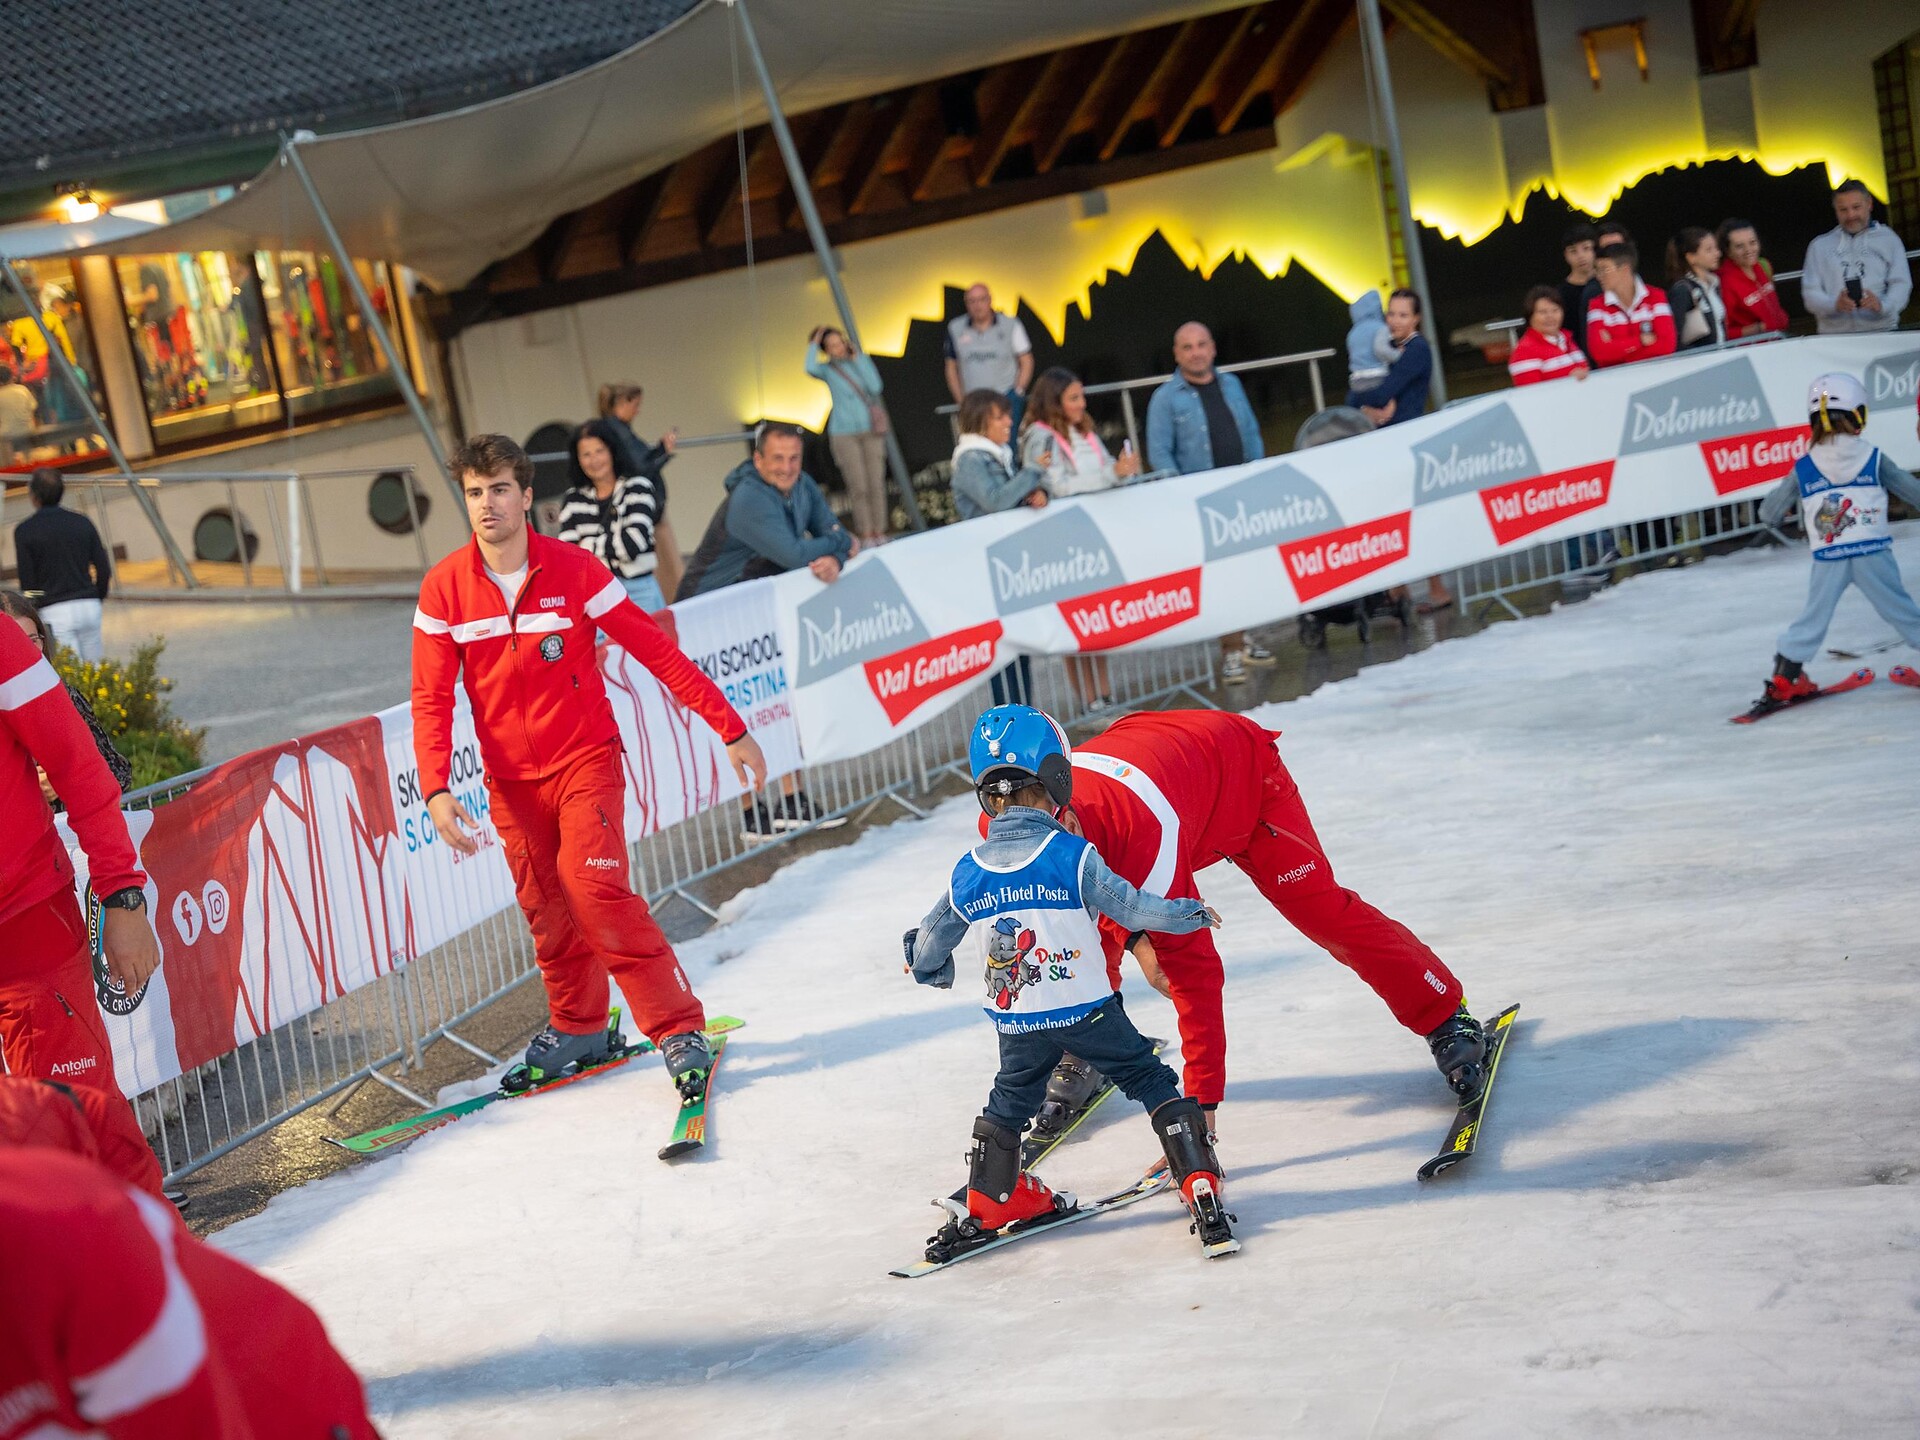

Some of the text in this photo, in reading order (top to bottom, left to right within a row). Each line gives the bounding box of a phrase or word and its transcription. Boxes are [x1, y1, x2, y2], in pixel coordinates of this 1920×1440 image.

[1632, 394, 1760, 443] Dolomites
[1419, 441, 1528, 492] Dolomites
[1712, 442, 1750, 474] Val
[1202, 494, 1329, 547] Dolomites
[1490, 477, 1603, 523] Val Gardena
[991, 546, 1110, 602] Dolomites
[1290, 529, 1404, 579] Val Gardena
[540, 595, 566, 609] COLMAR
[1071, 586, 1193, 638] Val Gardena
[719, 631, 782, 677] SCHOOL
[801, 601, 914, 667] Dolomites
[722, 666, 788, 709] RISTINA
[876, 640, 992, 699] Val Gardena
[585, 856, 620, 868] Antolini
[1277, 860, 1317, 886] Antolini
[1000, 884, 1034, 904] Hotel
[1036, 884, 1069, 902] Posta
[90, 907, 99, 956] SCUOLA
[1034, 947, 1081, 964] Dumbo
[1423, 969, 1447, 995] COLMAR
[51, 1055, 97, 1076] Antolini
[67, 1069, 86, 1077] ITALY
